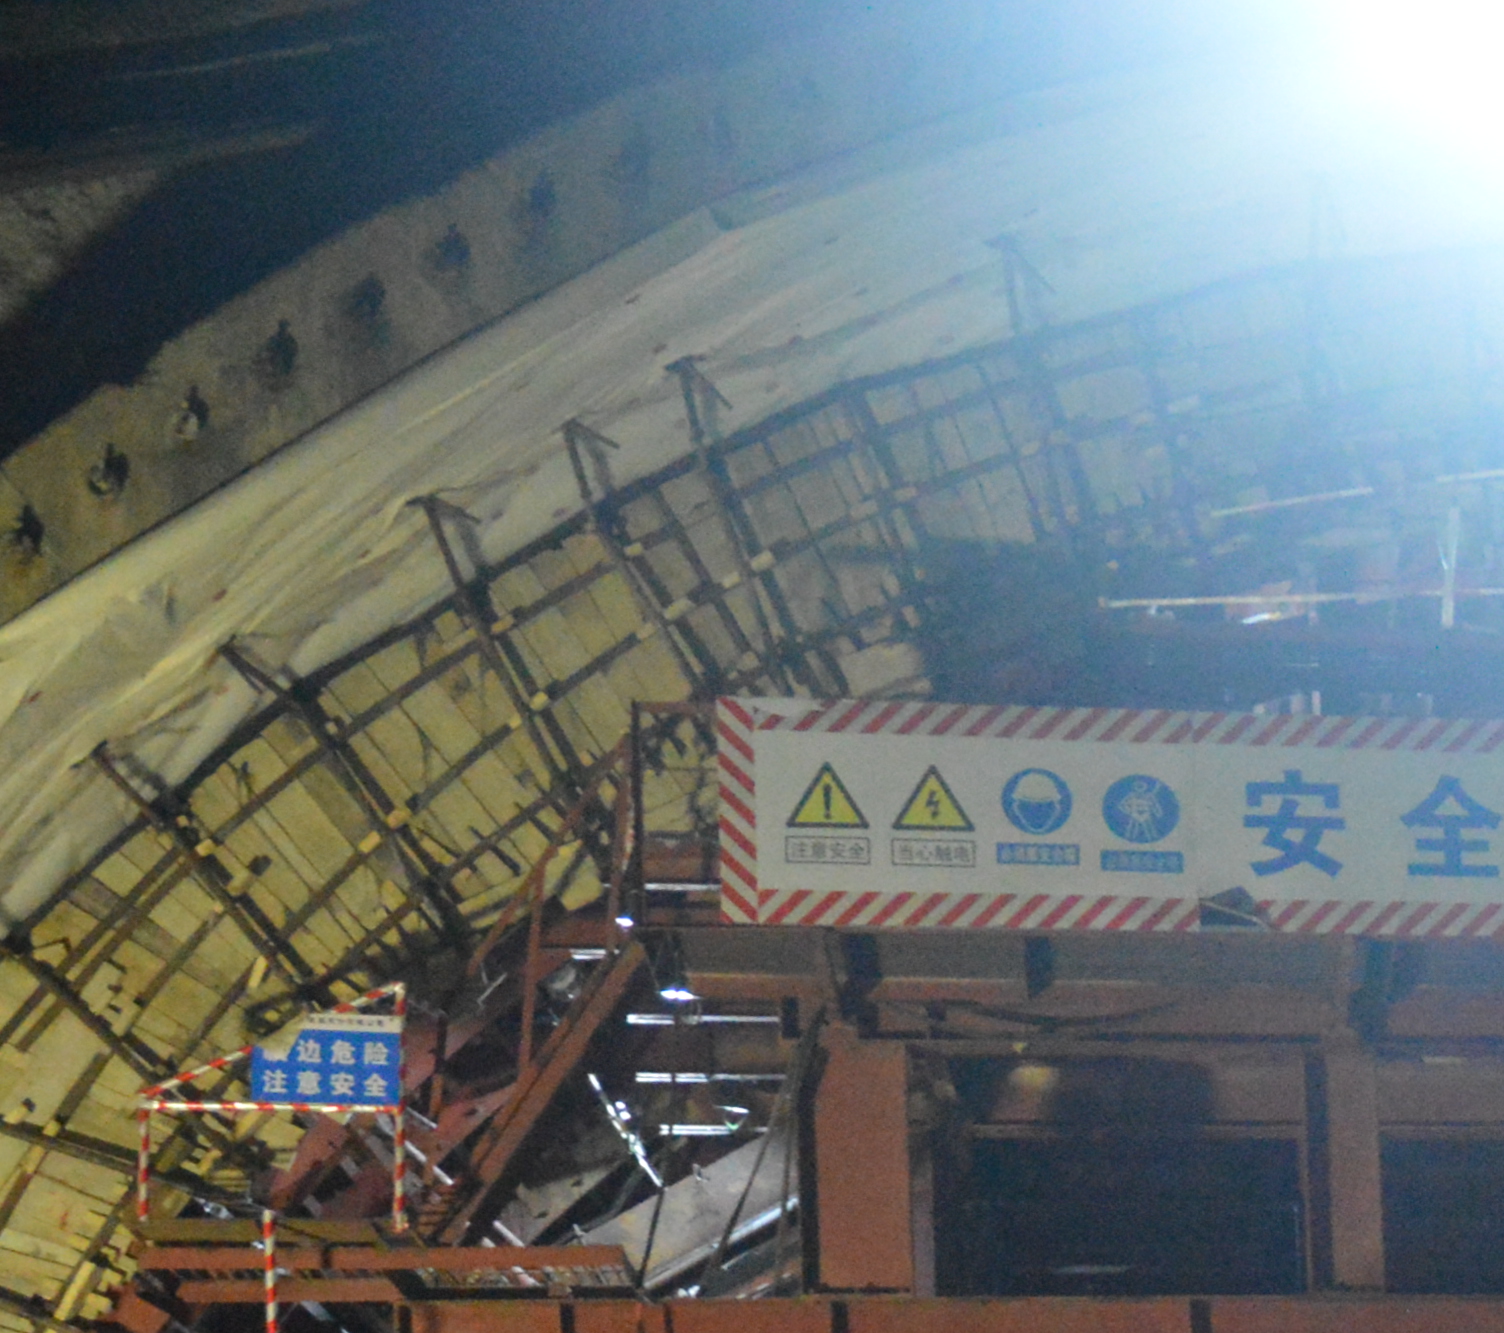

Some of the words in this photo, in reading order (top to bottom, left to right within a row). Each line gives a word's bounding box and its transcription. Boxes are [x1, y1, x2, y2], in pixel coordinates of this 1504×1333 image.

[791, 841, 866, 860] 注意安全
[263, 1039, 388, 1066] 边危险
[262, 1069, 388, 1097] 注意安全
